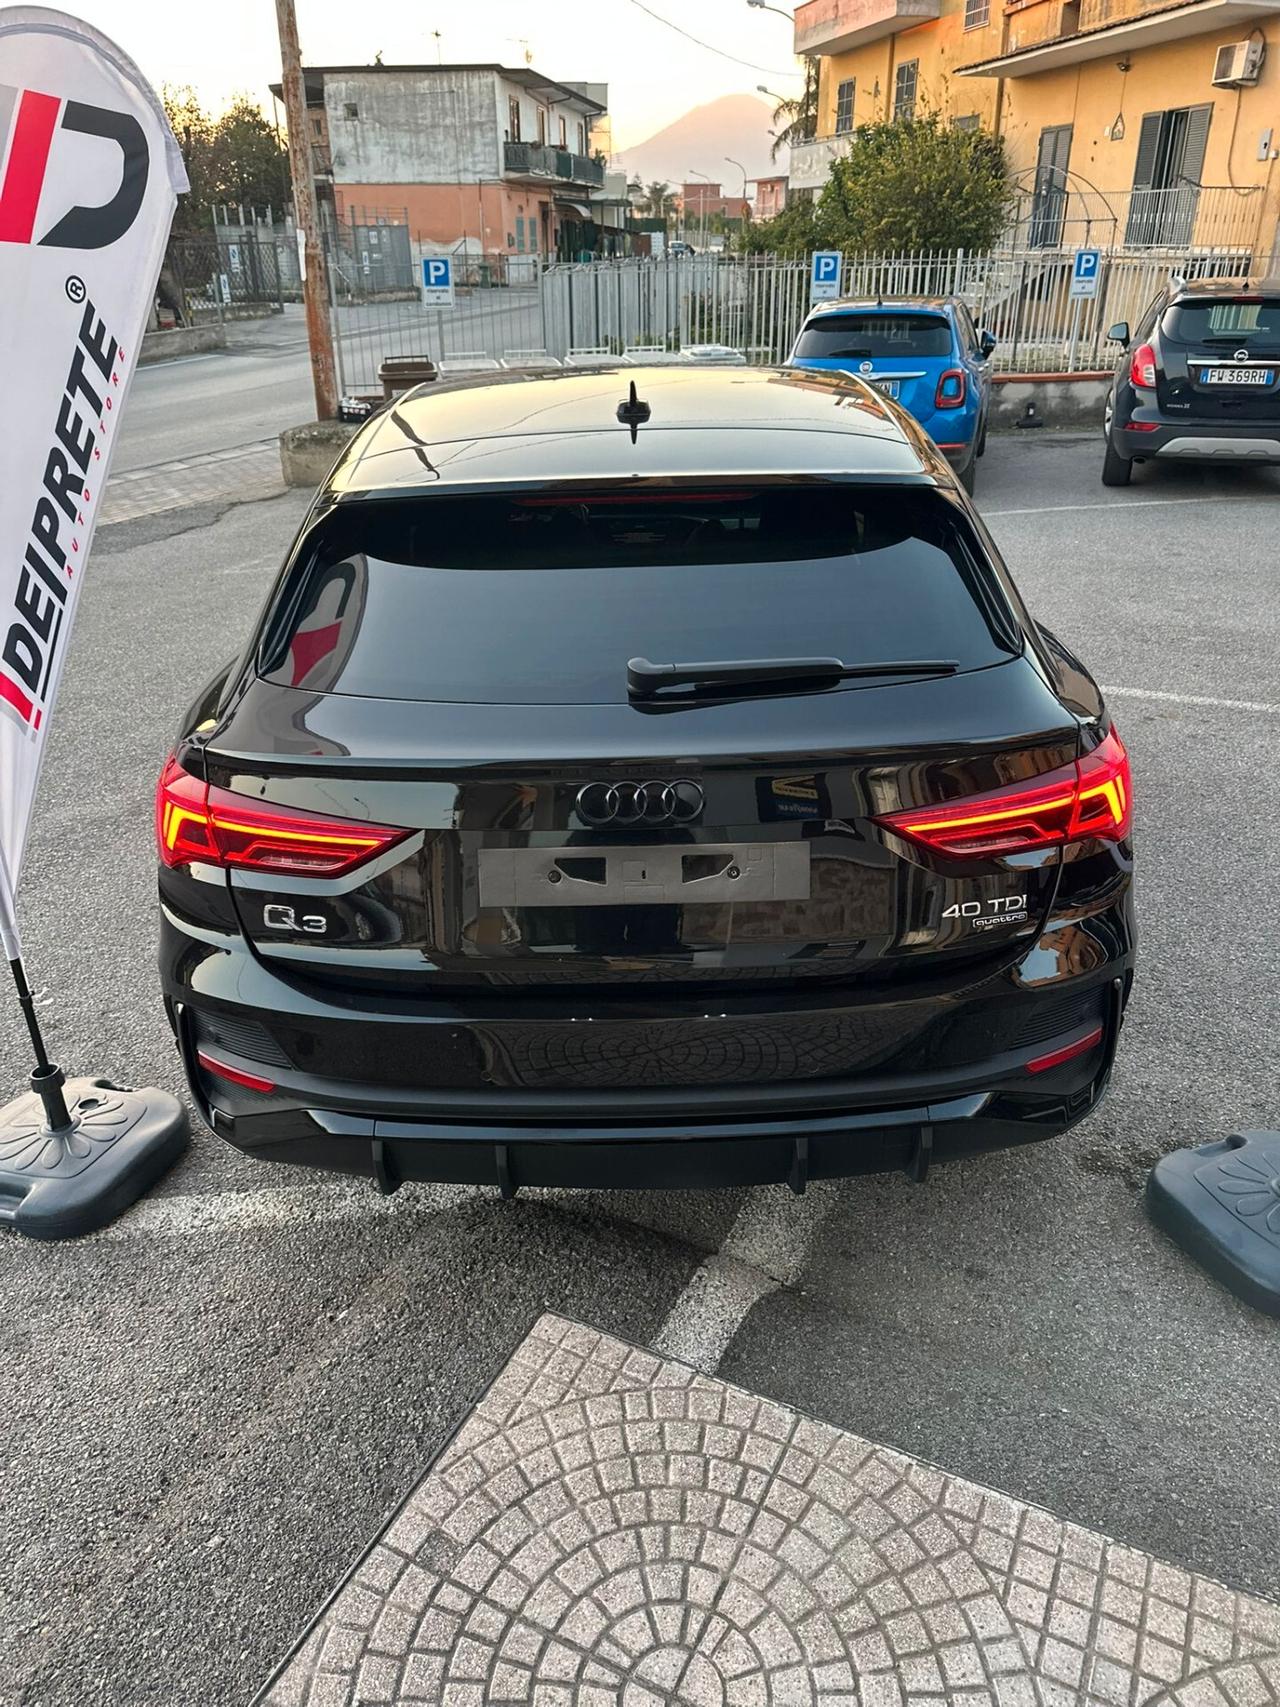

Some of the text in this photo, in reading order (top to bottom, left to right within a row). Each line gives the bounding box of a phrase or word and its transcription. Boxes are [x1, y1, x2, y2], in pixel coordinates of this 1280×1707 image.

[428, 261, 446, 284] P
[819, 257, 835, 280] P
[1080, 254, 1095, 276] P
[1228, 369, 1266, 383] 369RH
[66, 345, 126, 580] AUTO STORE
[3, 298, 118, 693] DEIPRETE
[942, 894, 1028, 918] 40 TDI
[263, 904, 327, 934] Q3
[974, 912, 1027, 928] quattro
